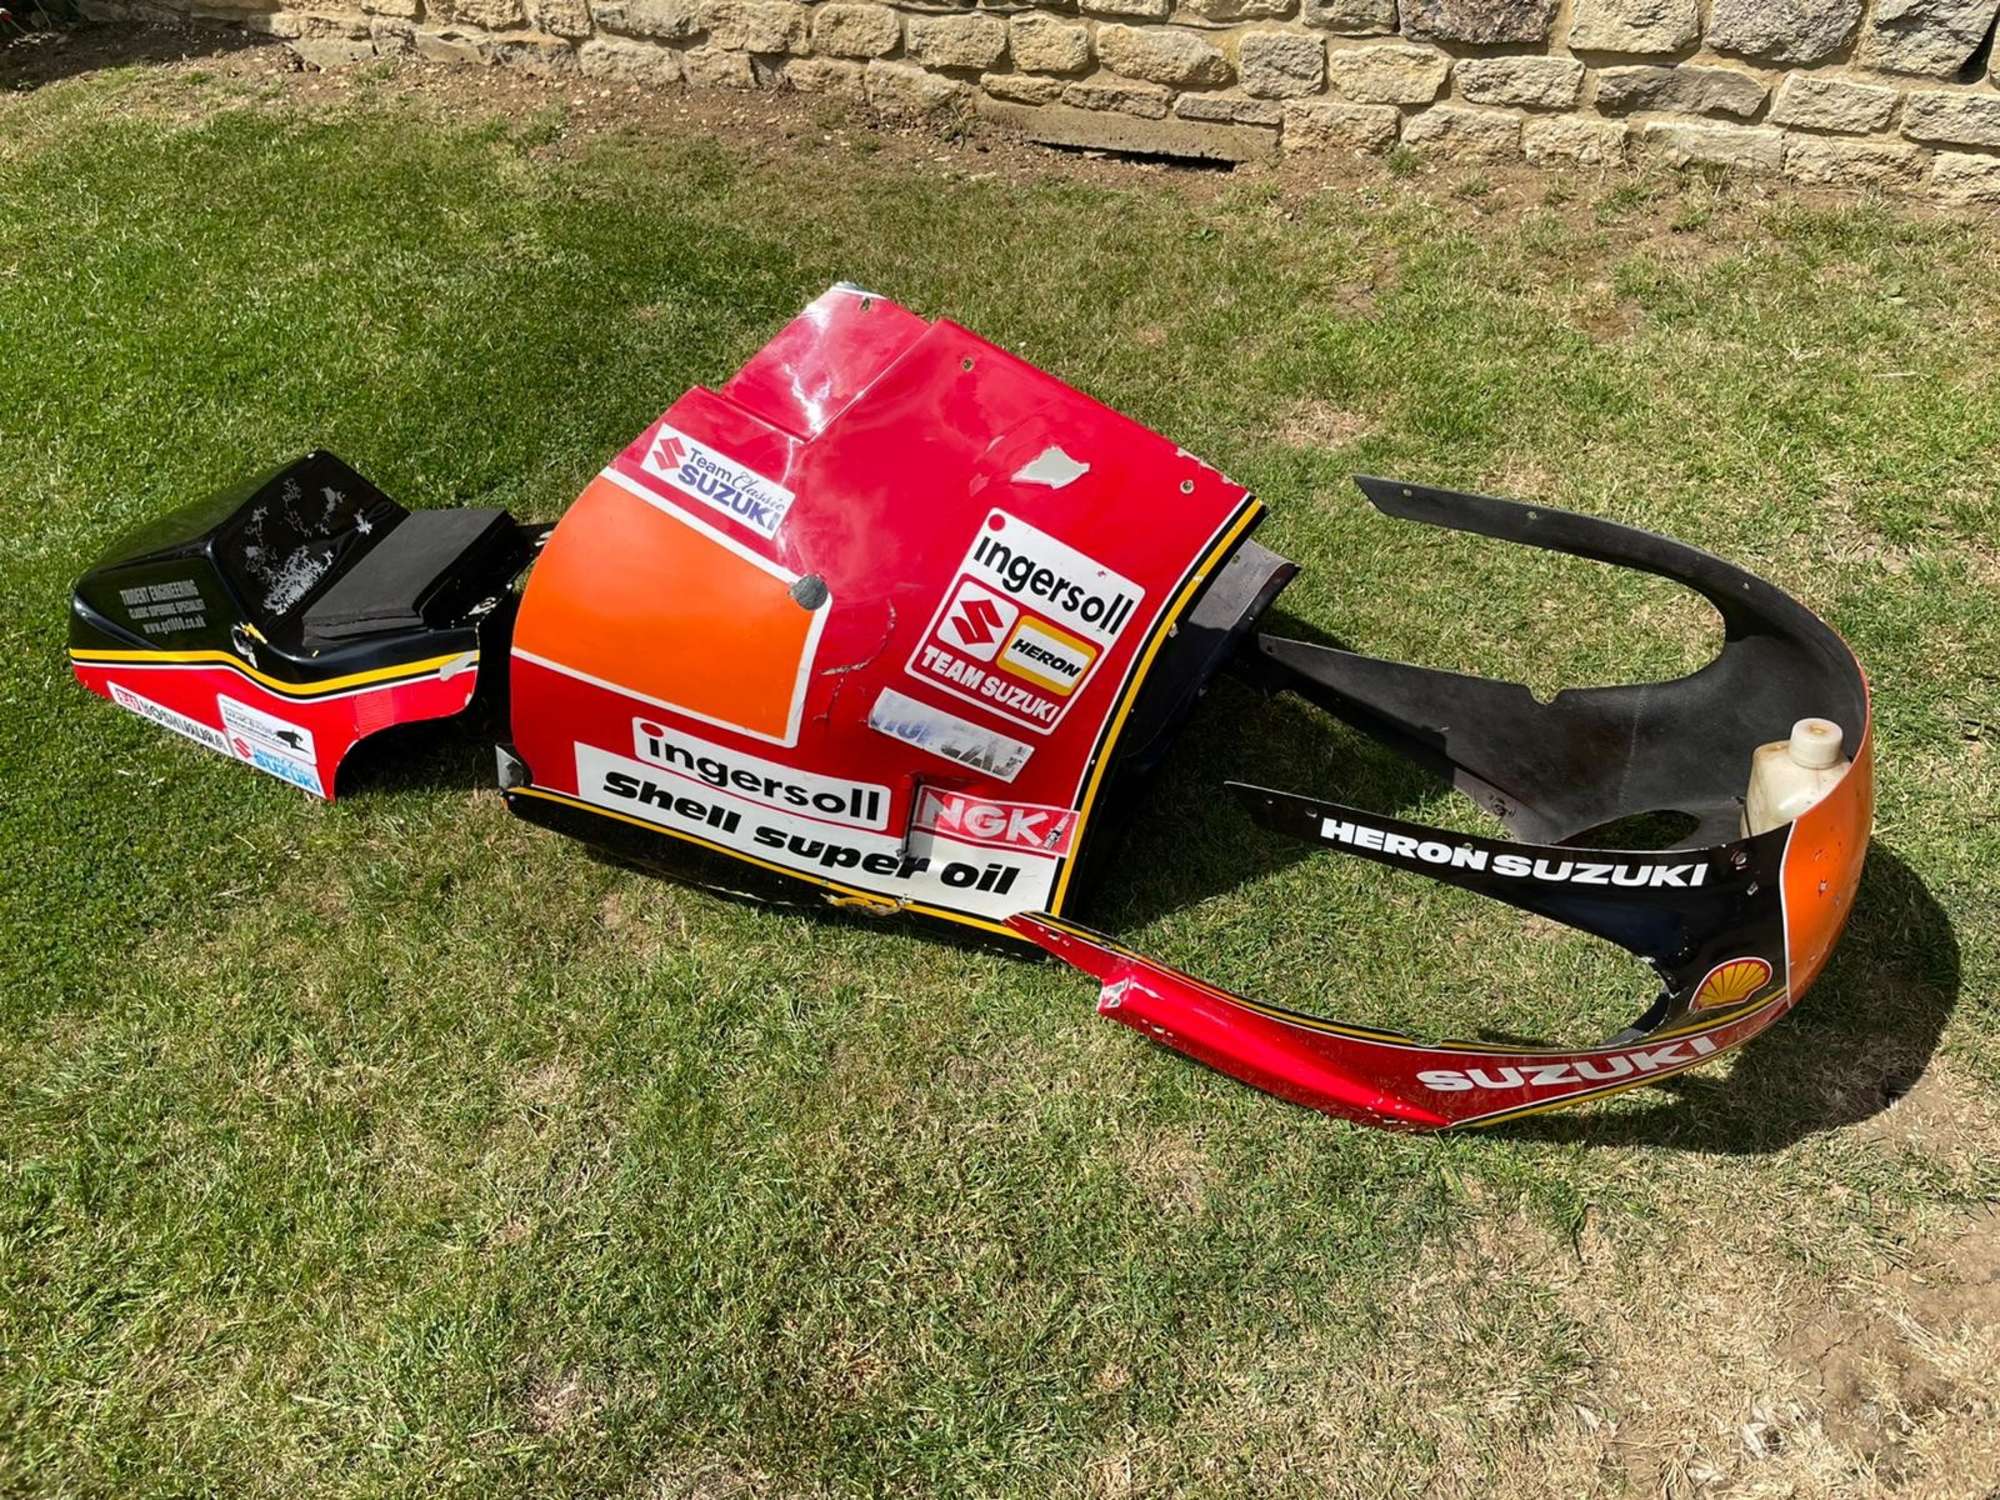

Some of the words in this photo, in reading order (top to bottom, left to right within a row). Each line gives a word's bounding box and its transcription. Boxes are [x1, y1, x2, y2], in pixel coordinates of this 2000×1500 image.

[677, 463, 782, 531] SUZUKI
[690, 447, 732, 482] Team
[731, 471, 786, 512] Classic
[973, 514, 1134, 636] ingersoll
[921, 645, 985, 690] TEAM
[981, 675, 1060, 723] SUZUKI
[1011, 638, 1081, 678] HERON
[253, 749, 322, 794] SUZUKI
[640, 723, 880, 822] ingersoll
[603, 771, 742, 835] Shell
[753, 824, 931, 881] super
[940, 862, 1021, 895] oil
[921, 791, 1049, 847] NGK
[1320, 817, 1488, 871] HERON
[1491, 854, 1710, 888] SUZUKI
[1416, 1036, 1720, 1092] SUZUKI
